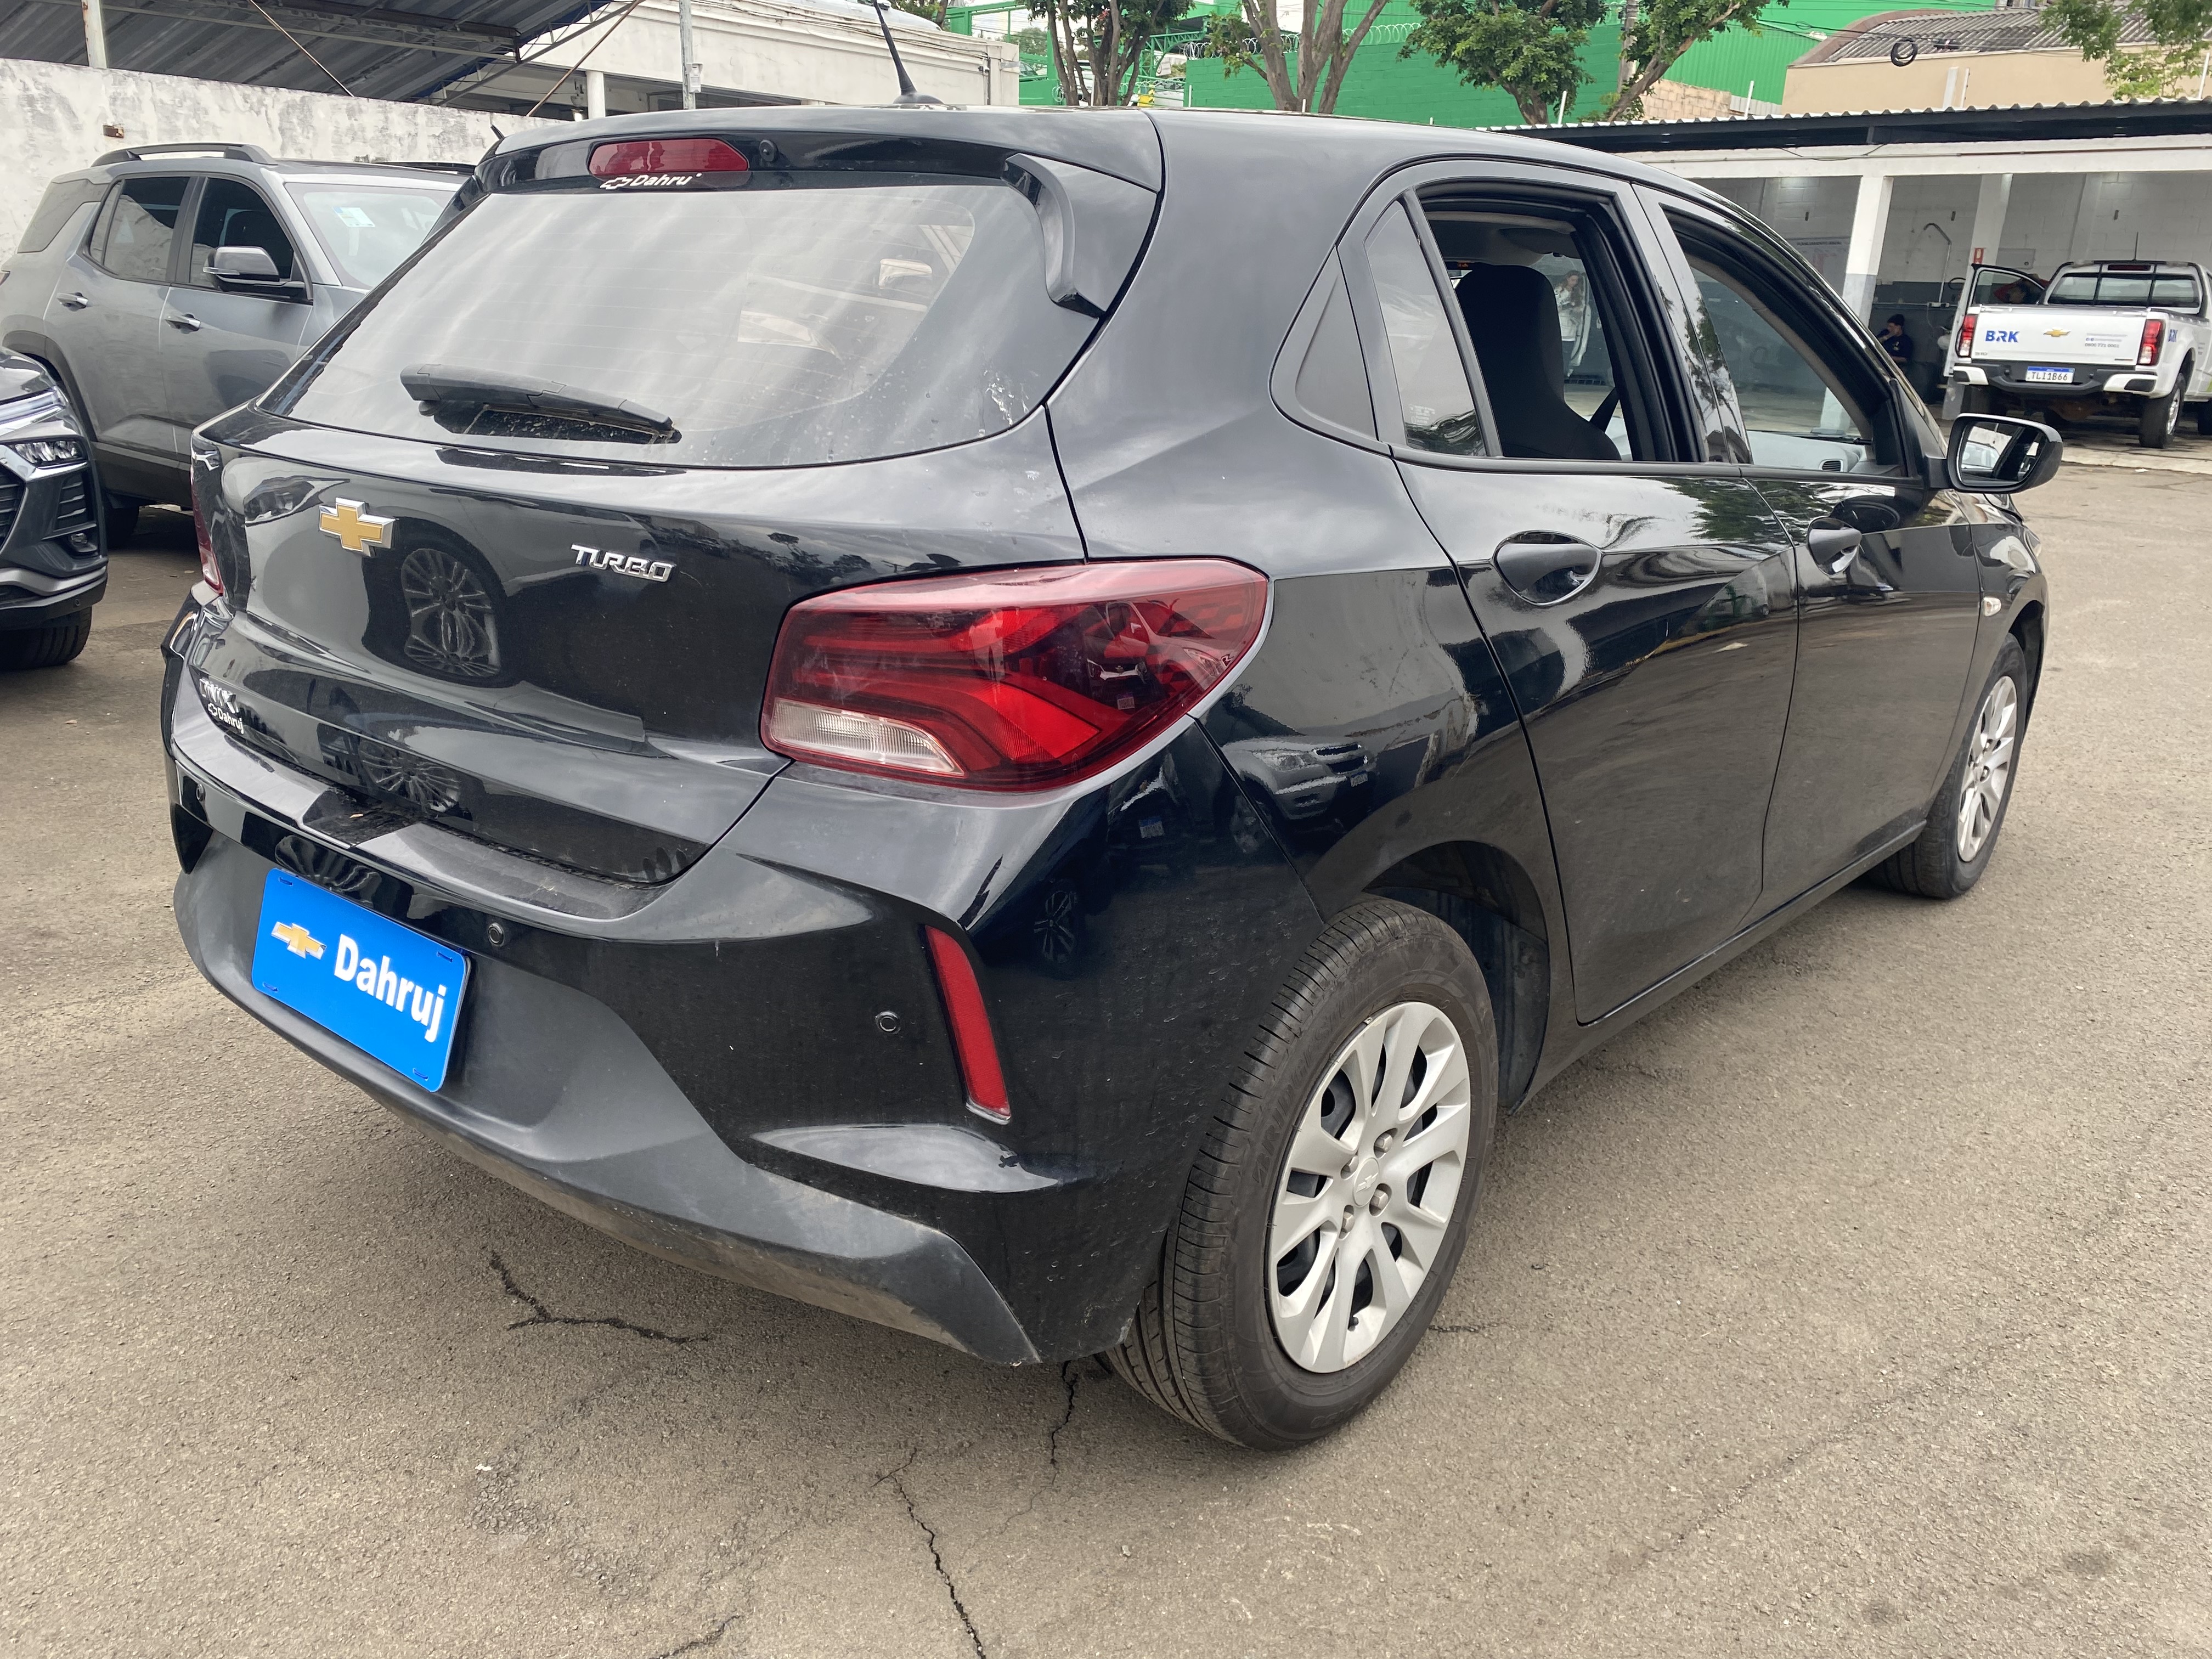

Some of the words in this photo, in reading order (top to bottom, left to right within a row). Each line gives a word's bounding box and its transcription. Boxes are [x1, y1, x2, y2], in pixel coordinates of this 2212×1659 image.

[629, 173, 702, 187] Dahru
[1985, 330, 2020, 343] BRK
[2032, 372, 2068, 381] TLI1B66
[571, 544, 676, 582] TURBO
[217, 707, 244, 734] Dahruj
[334, 933, 447, 1043] Dahruj
